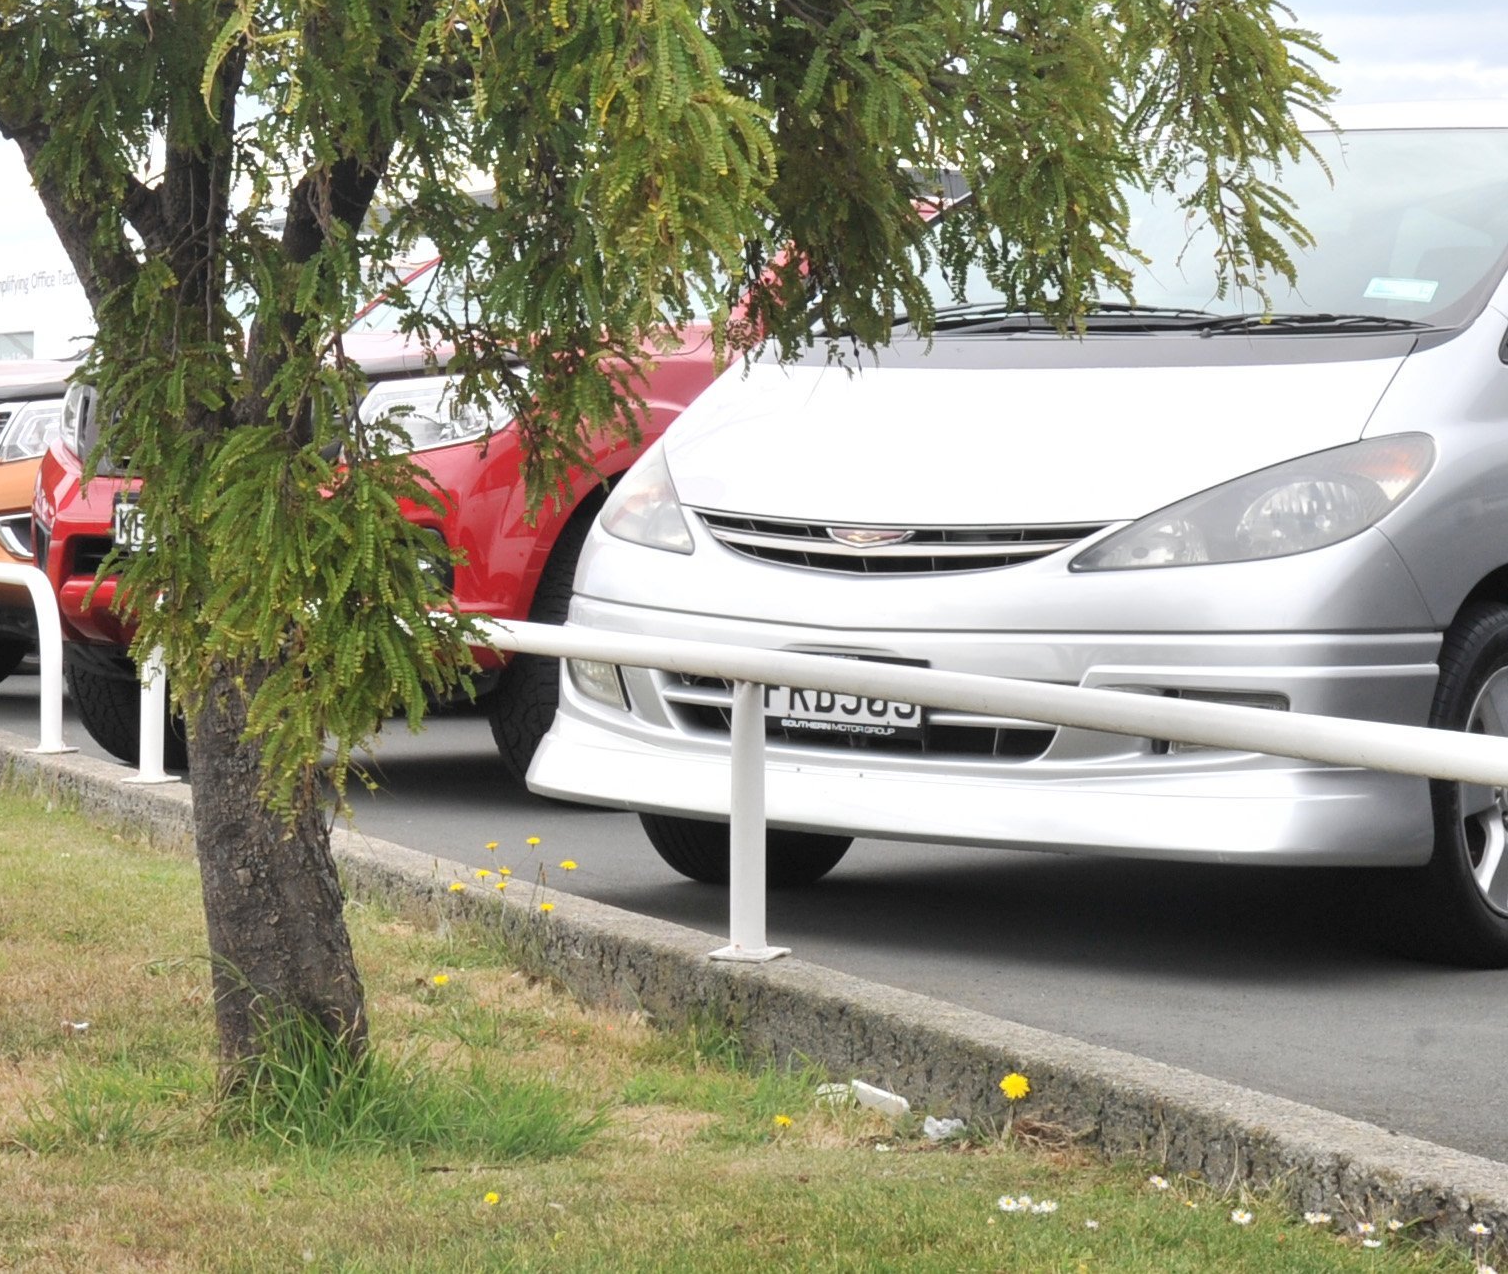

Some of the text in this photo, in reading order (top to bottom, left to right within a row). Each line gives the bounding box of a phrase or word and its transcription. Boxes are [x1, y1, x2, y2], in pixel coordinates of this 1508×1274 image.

[32, 271, 55, 289] Office
[58, 269, 78, 286] Tech
[781, 719, 896, 736] SOUTHERN MOTOR GROUP
